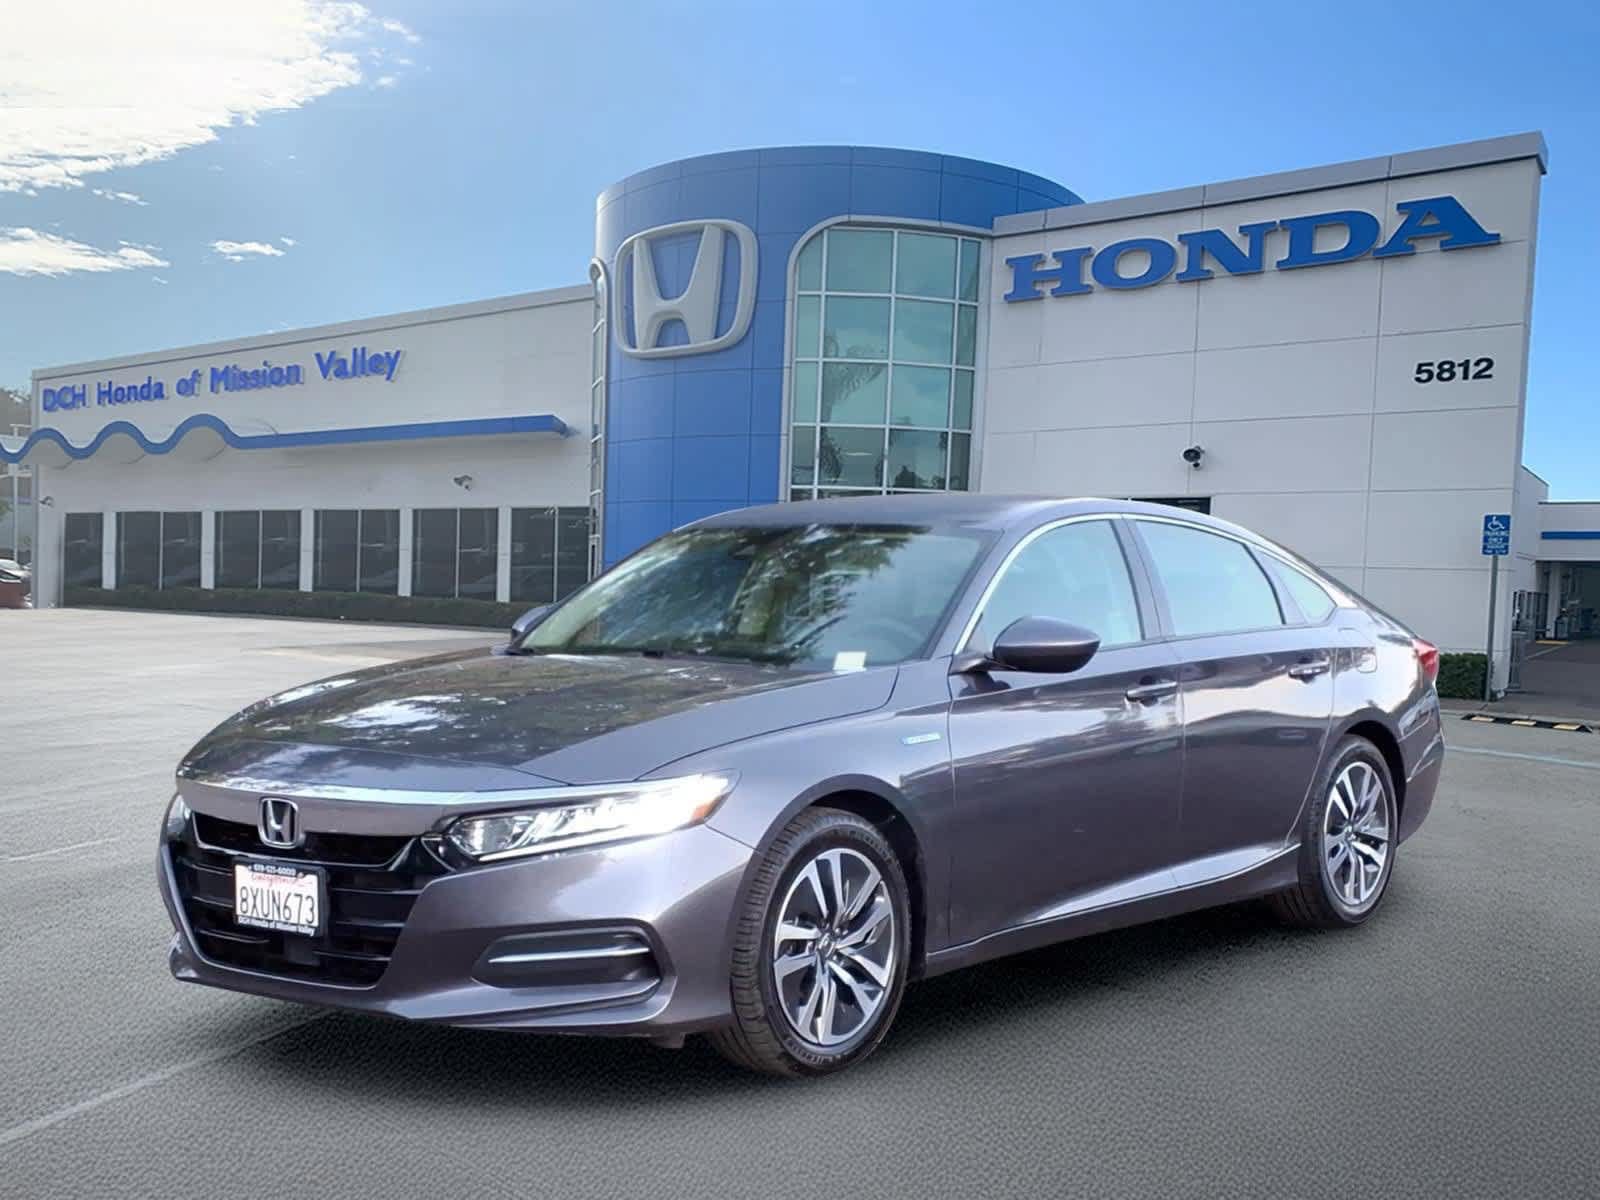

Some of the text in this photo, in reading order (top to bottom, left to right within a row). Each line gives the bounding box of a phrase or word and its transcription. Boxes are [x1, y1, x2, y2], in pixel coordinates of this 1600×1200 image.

[1004, 195, 1501, 302] HONDA
[42, 346, 401, 412] DCH Honda of Mission Valley
[1414, 357, 1495, 383] 5812
[239, 886, 316, 925] 8XUN673
